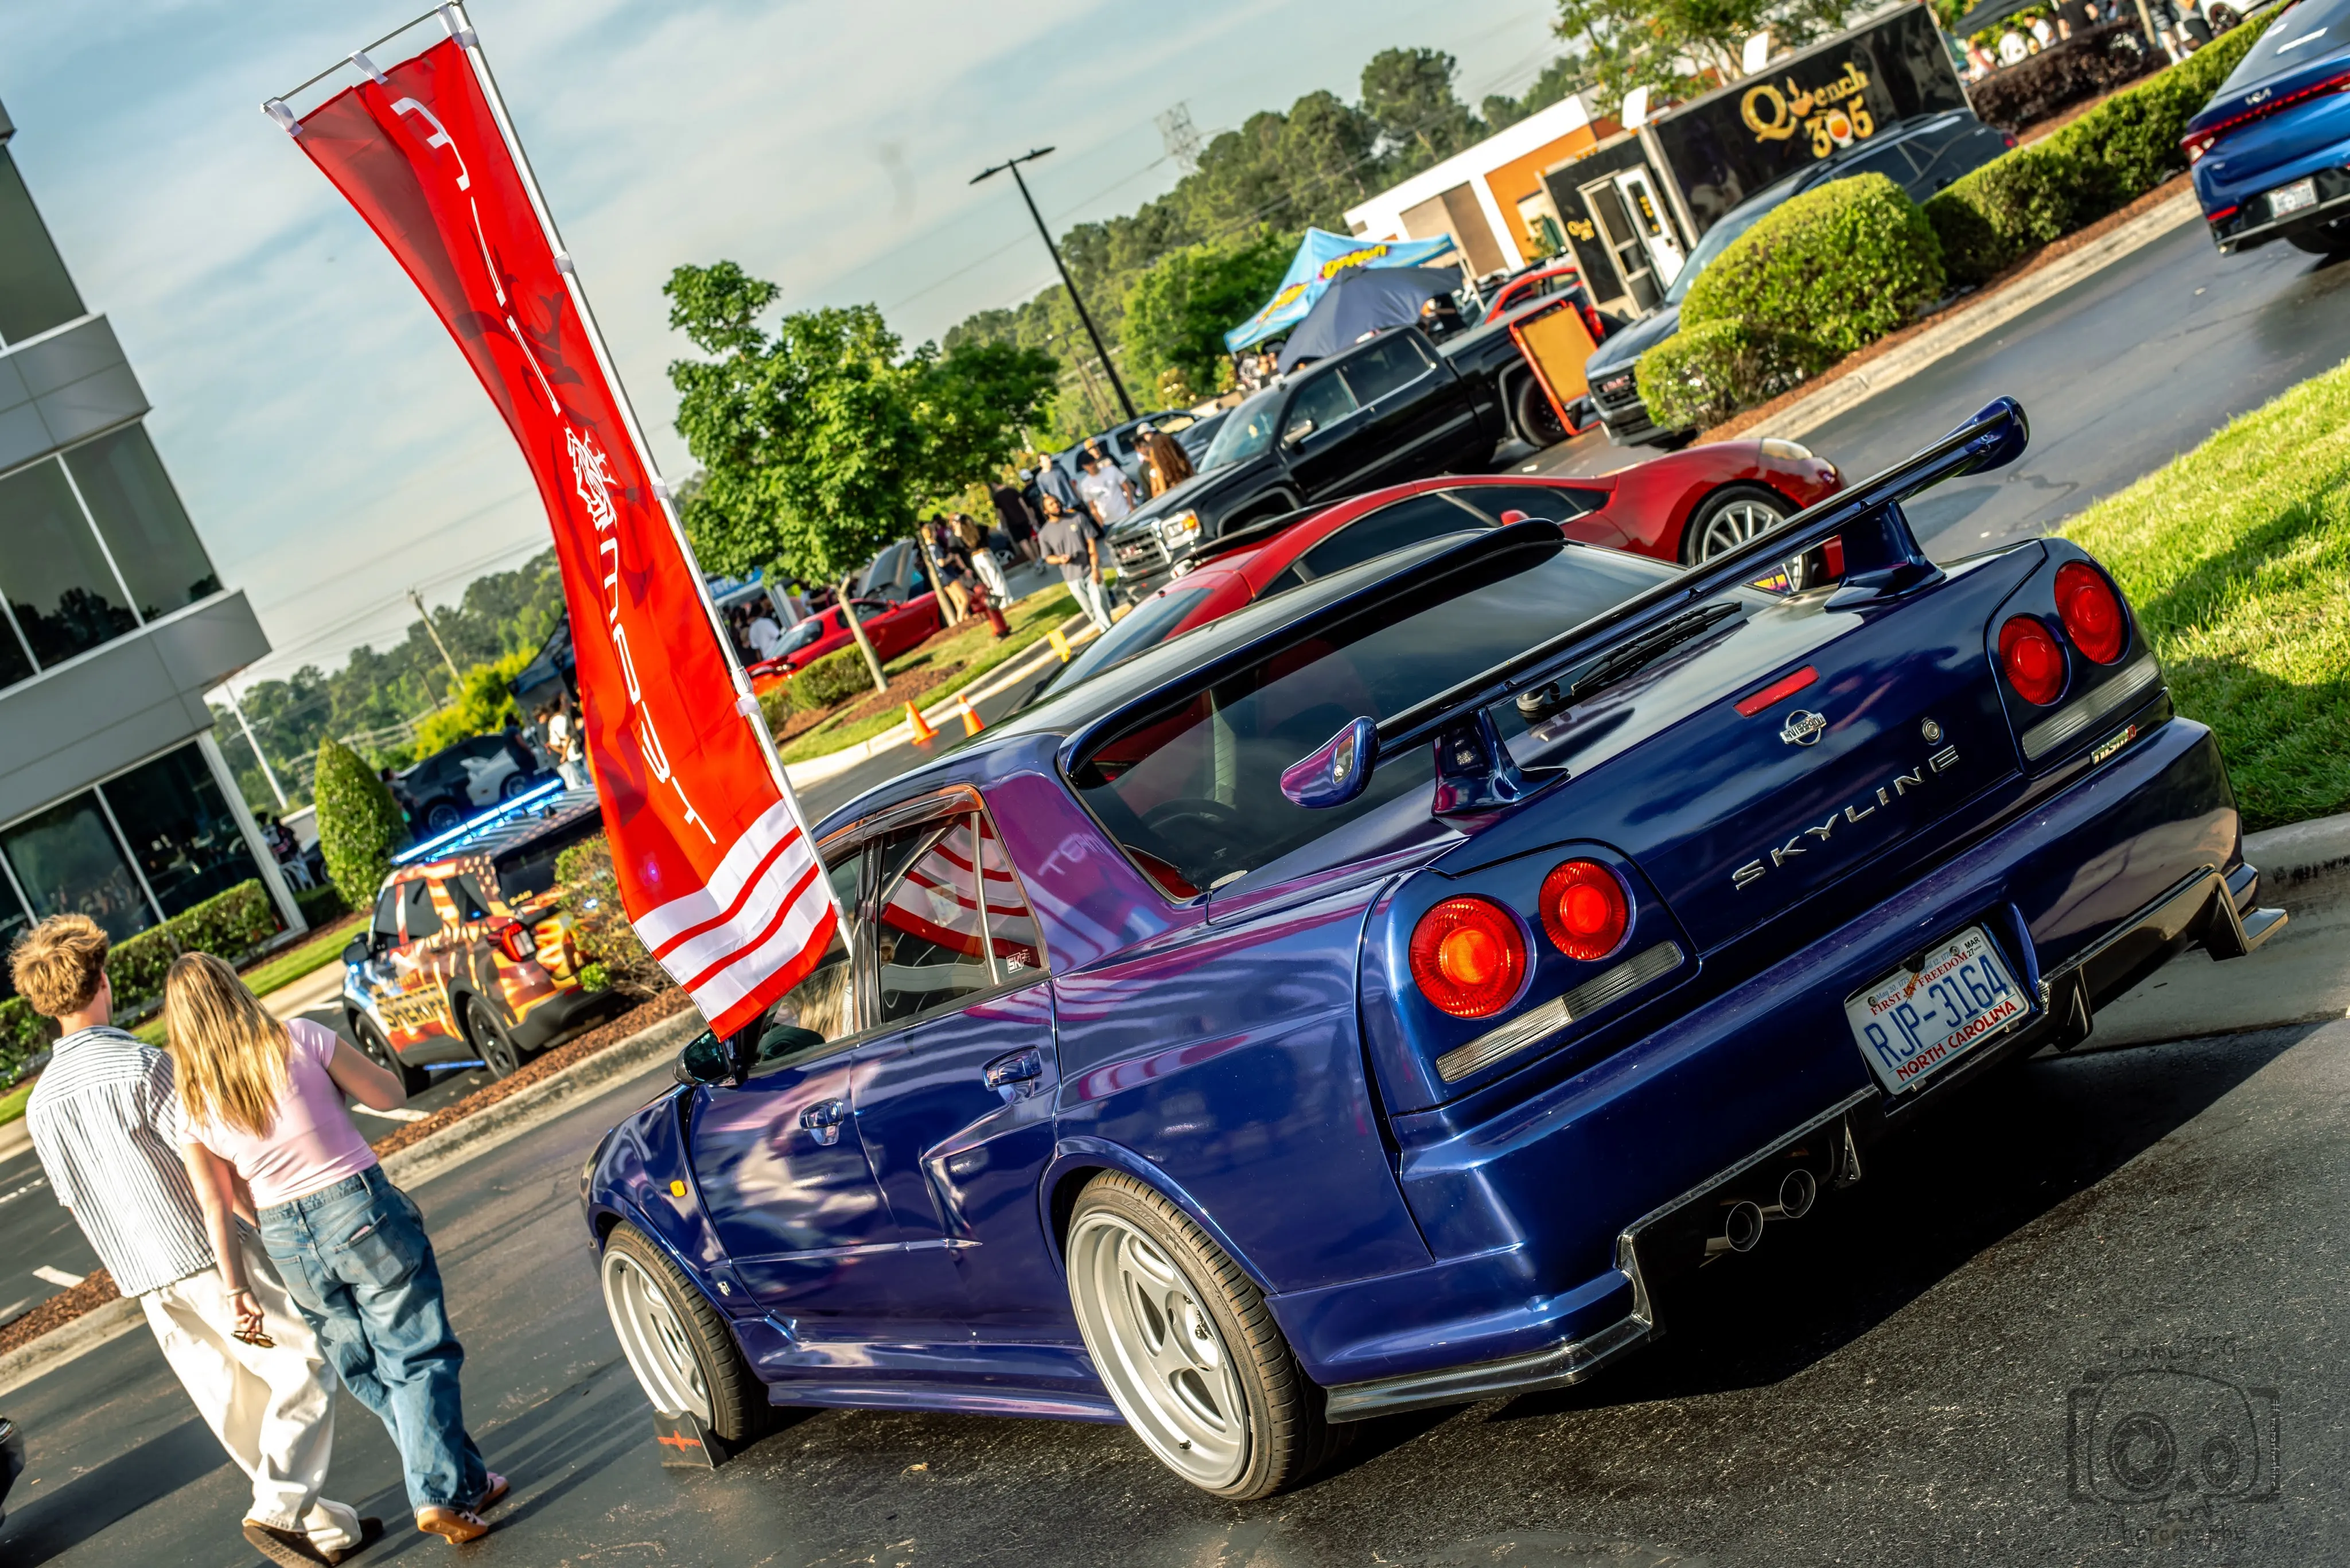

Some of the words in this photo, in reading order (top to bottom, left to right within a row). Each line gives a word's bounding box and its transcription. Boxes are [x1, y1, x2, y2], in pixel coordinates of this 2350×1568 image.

[1788, 715, 1823, 738] NISSAN
[1732, 744, 1960, 890] SKYLINE
[1964, 936, 1981, 950] MAR
[1966, 947, 1975, 958] 27
[1870, 991, 1902, 1017] FIRST
[1918, 951, 1969, 986] FREEDOM
[1876, 988, 1890, 1002] May
[1897, 976, 1911, 989] 1775
[1863, 955, 2011, 1068] RJP-3164
[1896, 1043, 1947, 1082] NORTH
[1948, 1000, 2018, 1049] CAROLINA
